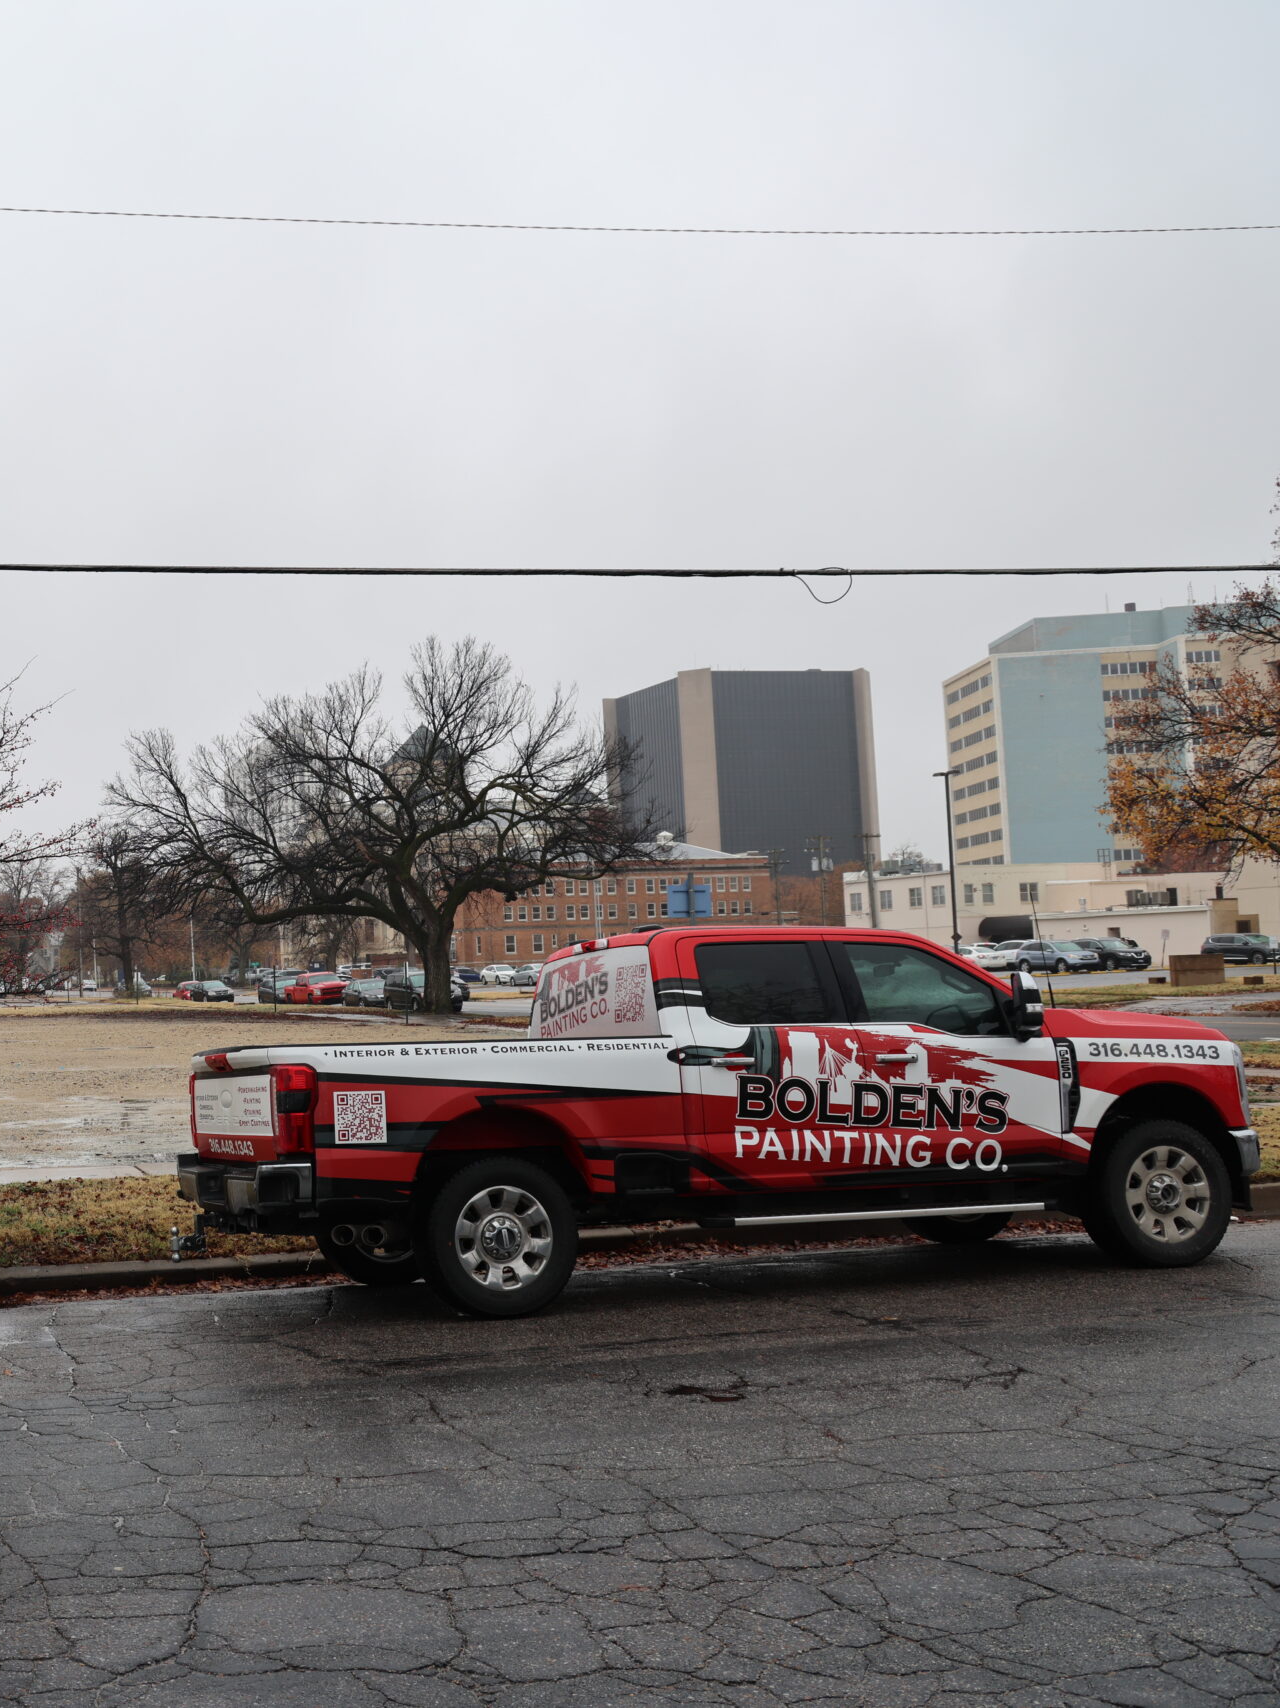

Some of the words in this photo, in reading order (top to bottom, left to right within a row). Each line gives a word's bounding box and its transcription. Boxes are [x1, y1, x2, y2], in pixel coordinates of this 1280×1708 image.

[540, 972, 609, 1023] BOLDEN'S
[540, 1008, 588, 1038] PAINTING
[590, 998, 610, 1020] CO.
[333, 1047, 396, 1058] INTERIOR
[400, 1047, 411, 1056] &
[414, 1046, 479, 1056] EXTERIOR
[490, 1043, 575, 1055] COMMERCIAL
[586, 1041, 670, 1052] RESIDENTIAL
[1088, 1042, 1220, 1060] 316.448.1343
[735, 1072, 1011, 1135] BOLDEN'S
[208, 1138, 255, 1157] 316.448.1343
[734, 1125, 933, 1168] PAINTING
[945, 1137, 1009, 1173] CO.
